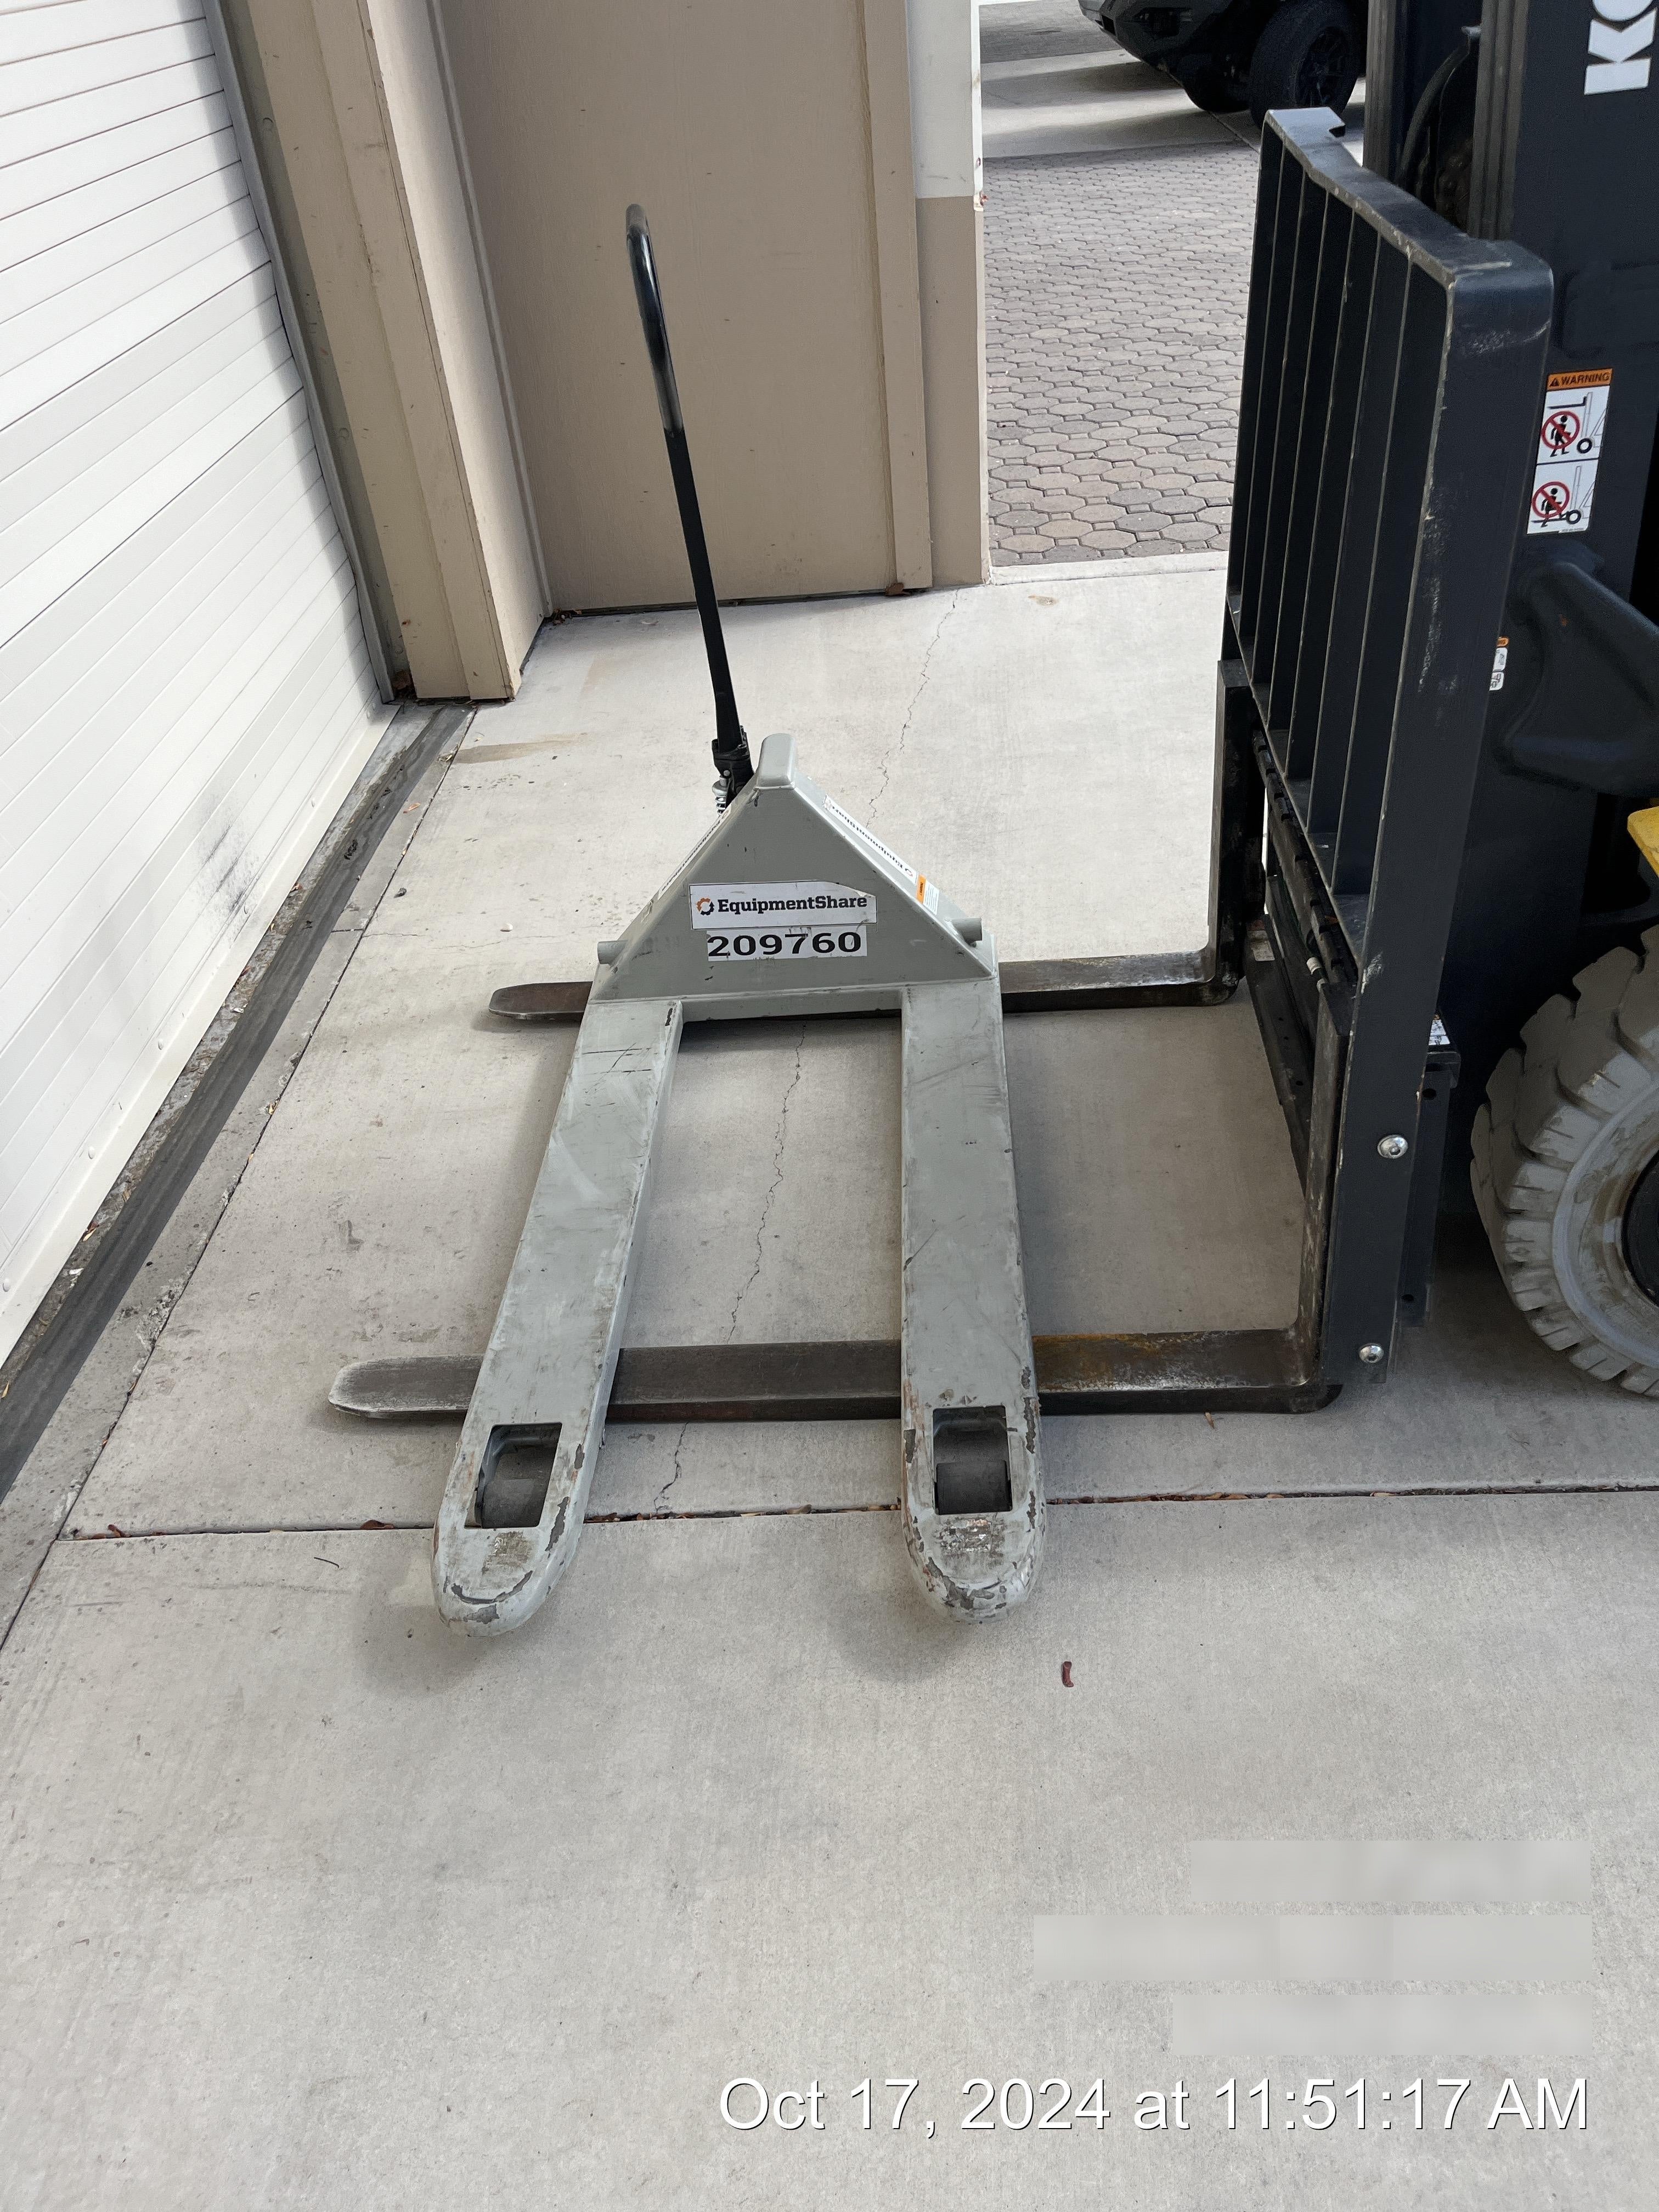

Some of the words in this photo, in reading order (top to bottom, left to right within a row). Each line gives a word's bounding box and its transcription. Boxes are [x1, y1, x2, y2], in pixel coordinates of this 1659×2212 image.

[1561, 372, 1609, 385] WARNING
[718, 895, 867, 915] EquipmentShare
[707, 932, 861, 957] 209760
